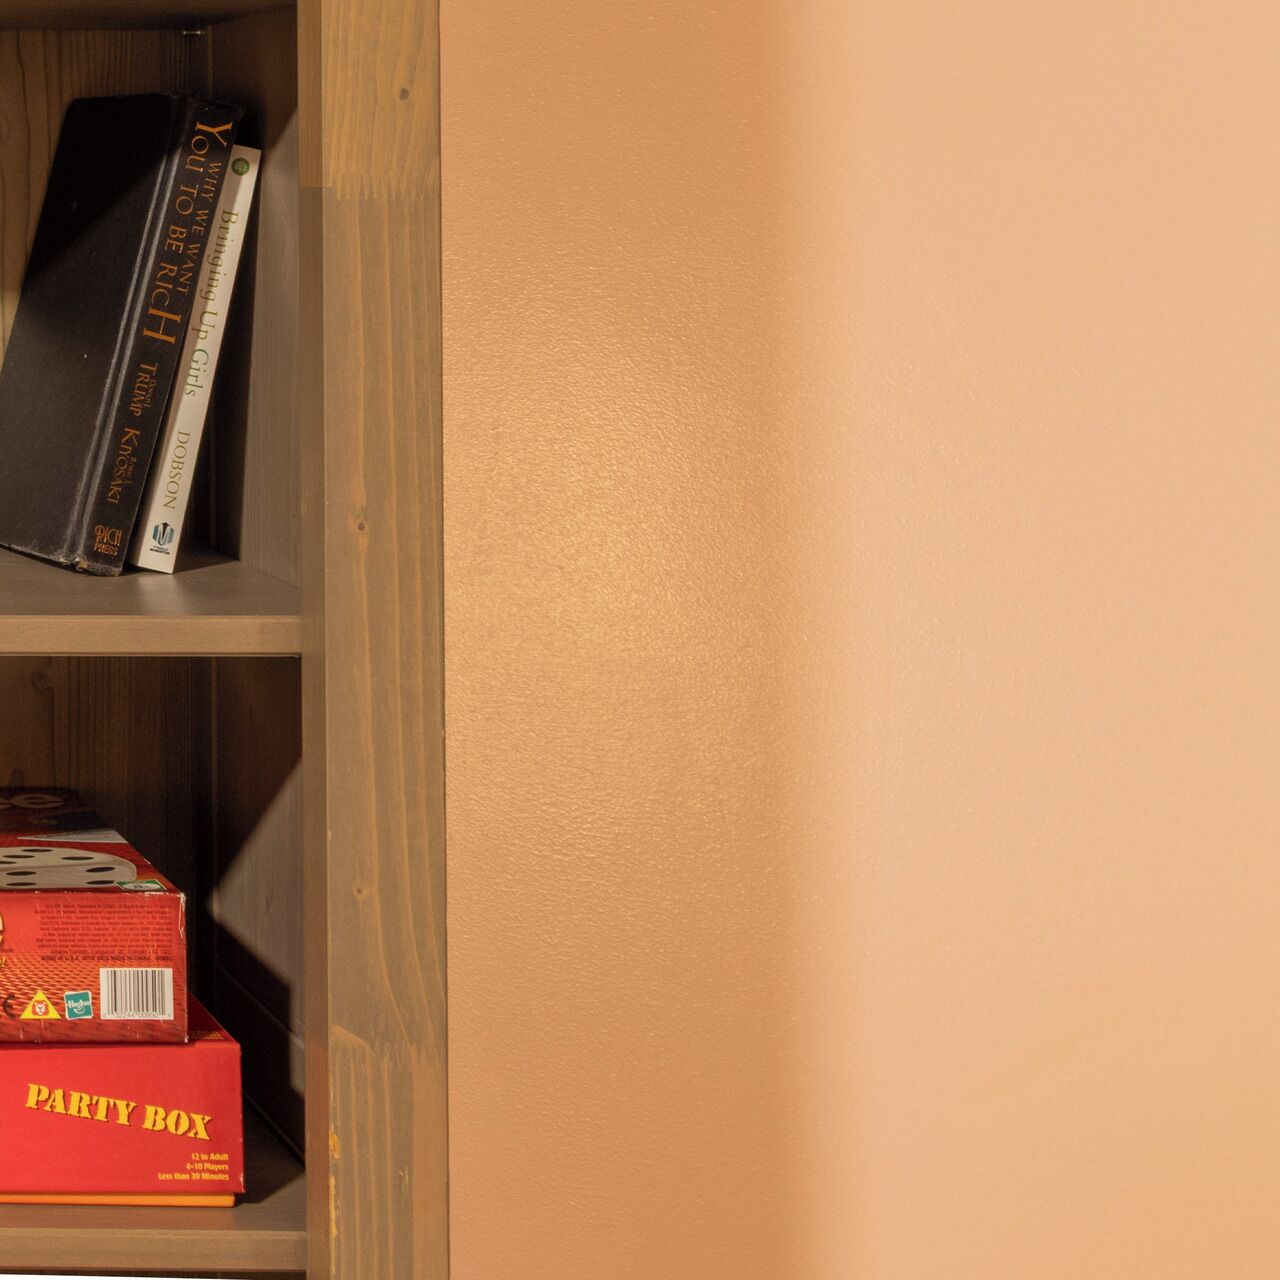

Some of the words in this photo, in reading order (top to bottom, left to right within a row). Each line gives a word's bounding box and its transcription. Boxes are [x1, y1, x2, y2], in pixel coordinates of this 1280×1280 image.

[176, 184, 199, 214] TO
[164, 224, 188, 253] BE
[199, 209, 239, 301] Bringing
[143, 262, 182, 344] RICH
[191, 310, 218, 341] Up
[183, 348, 210, 397] Girls
[163, 430, 190, 509] DOBSON
[25, 1083, 138, 1126] PARTY
[142, 1105, 212, 1140] BOX
